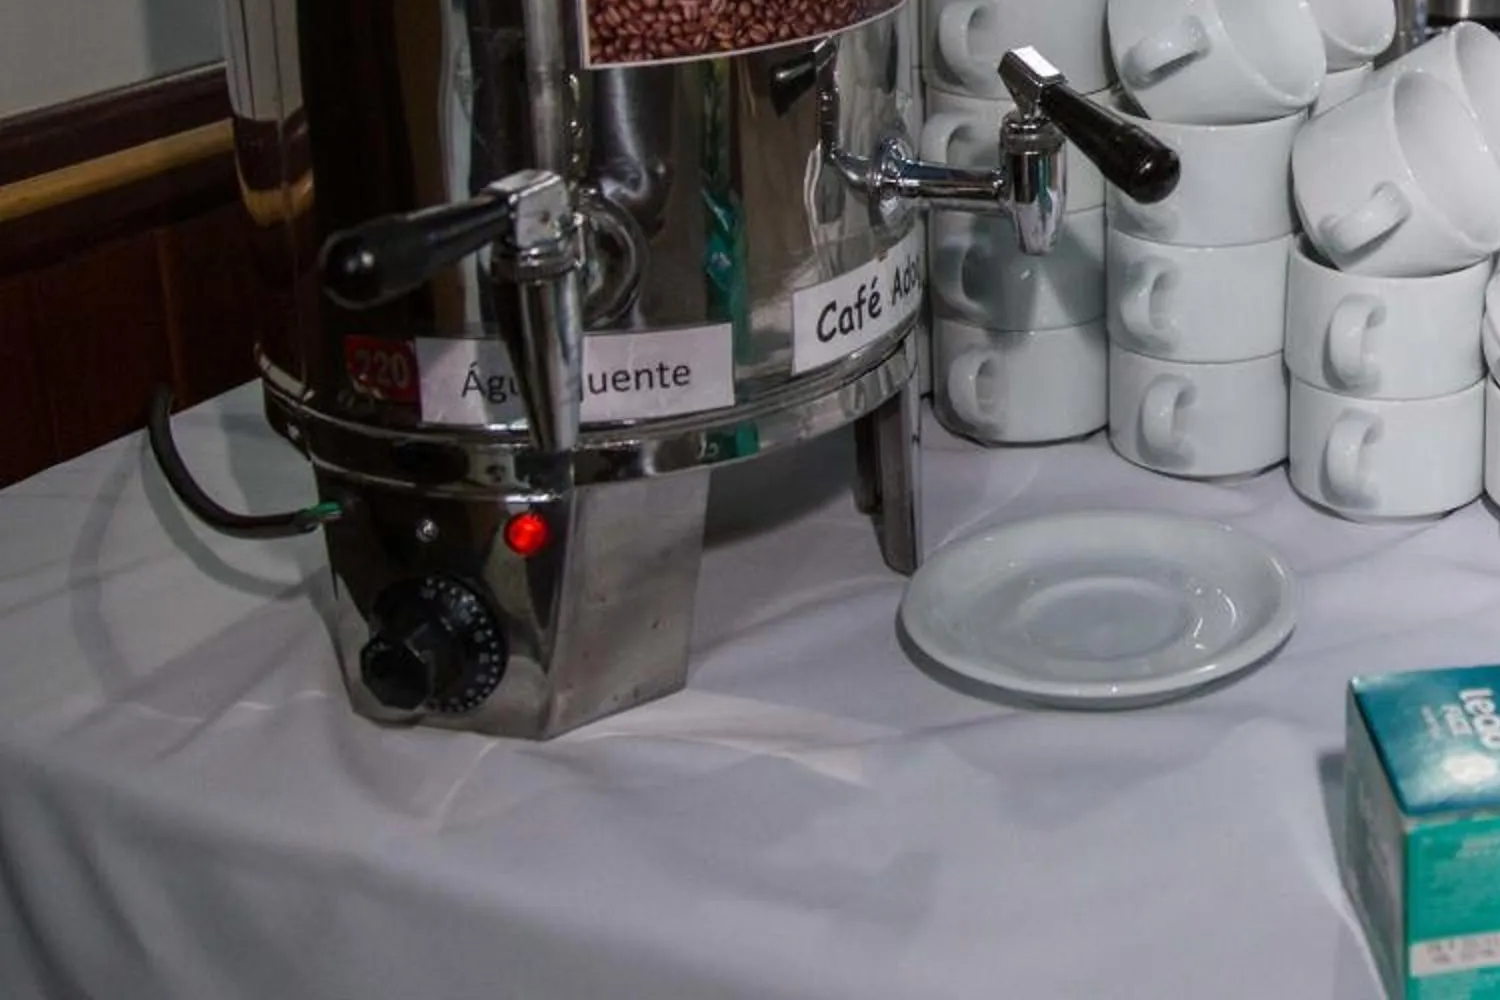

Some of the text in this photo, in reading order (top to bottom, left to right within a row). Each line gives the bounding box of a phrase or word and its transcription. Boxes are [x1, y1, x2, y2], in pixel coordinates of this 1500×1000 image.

[817, 255, 922, 342] Café Ado
[581, 362, 692, 401] uente
